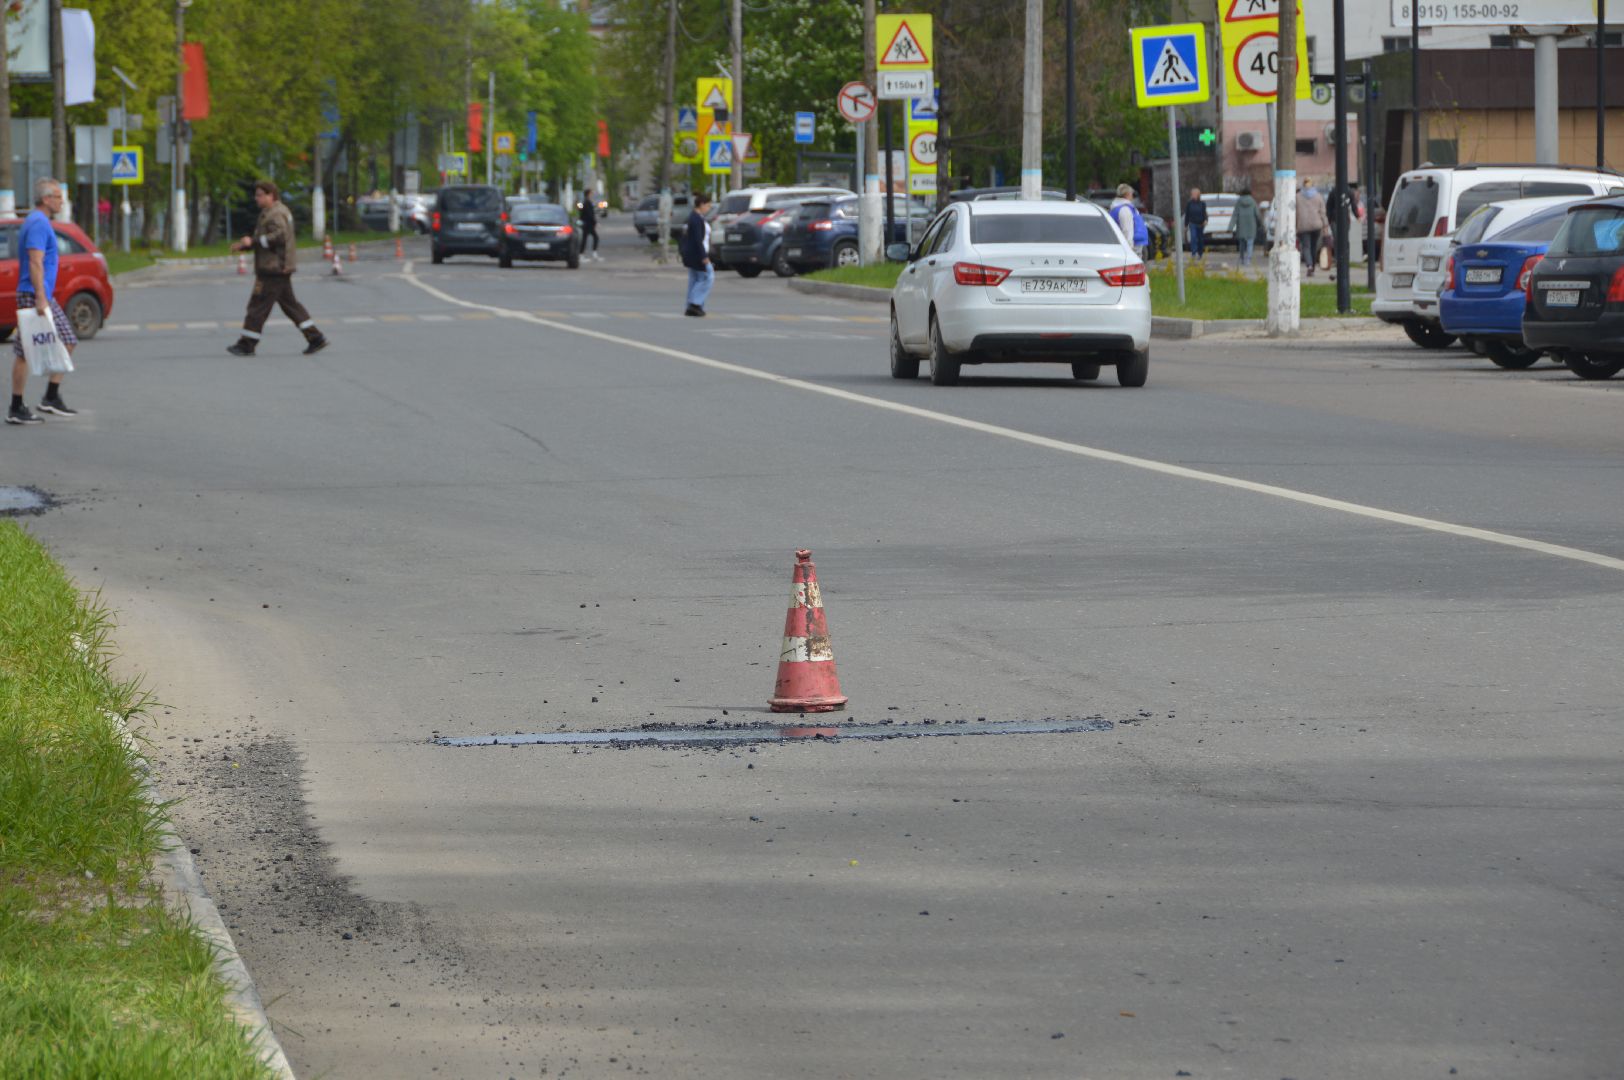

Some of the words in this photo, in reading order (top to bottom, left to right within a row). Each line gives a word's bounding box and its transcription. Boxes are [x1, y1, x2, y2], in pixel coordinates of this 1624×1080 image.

[1418, 4, 1448, 20] 915)
[1453, 4, 1519, 18] 155-00-92
[1250, 50, 1279, 75] 40
[1068, 279, 1084, 288] 797
